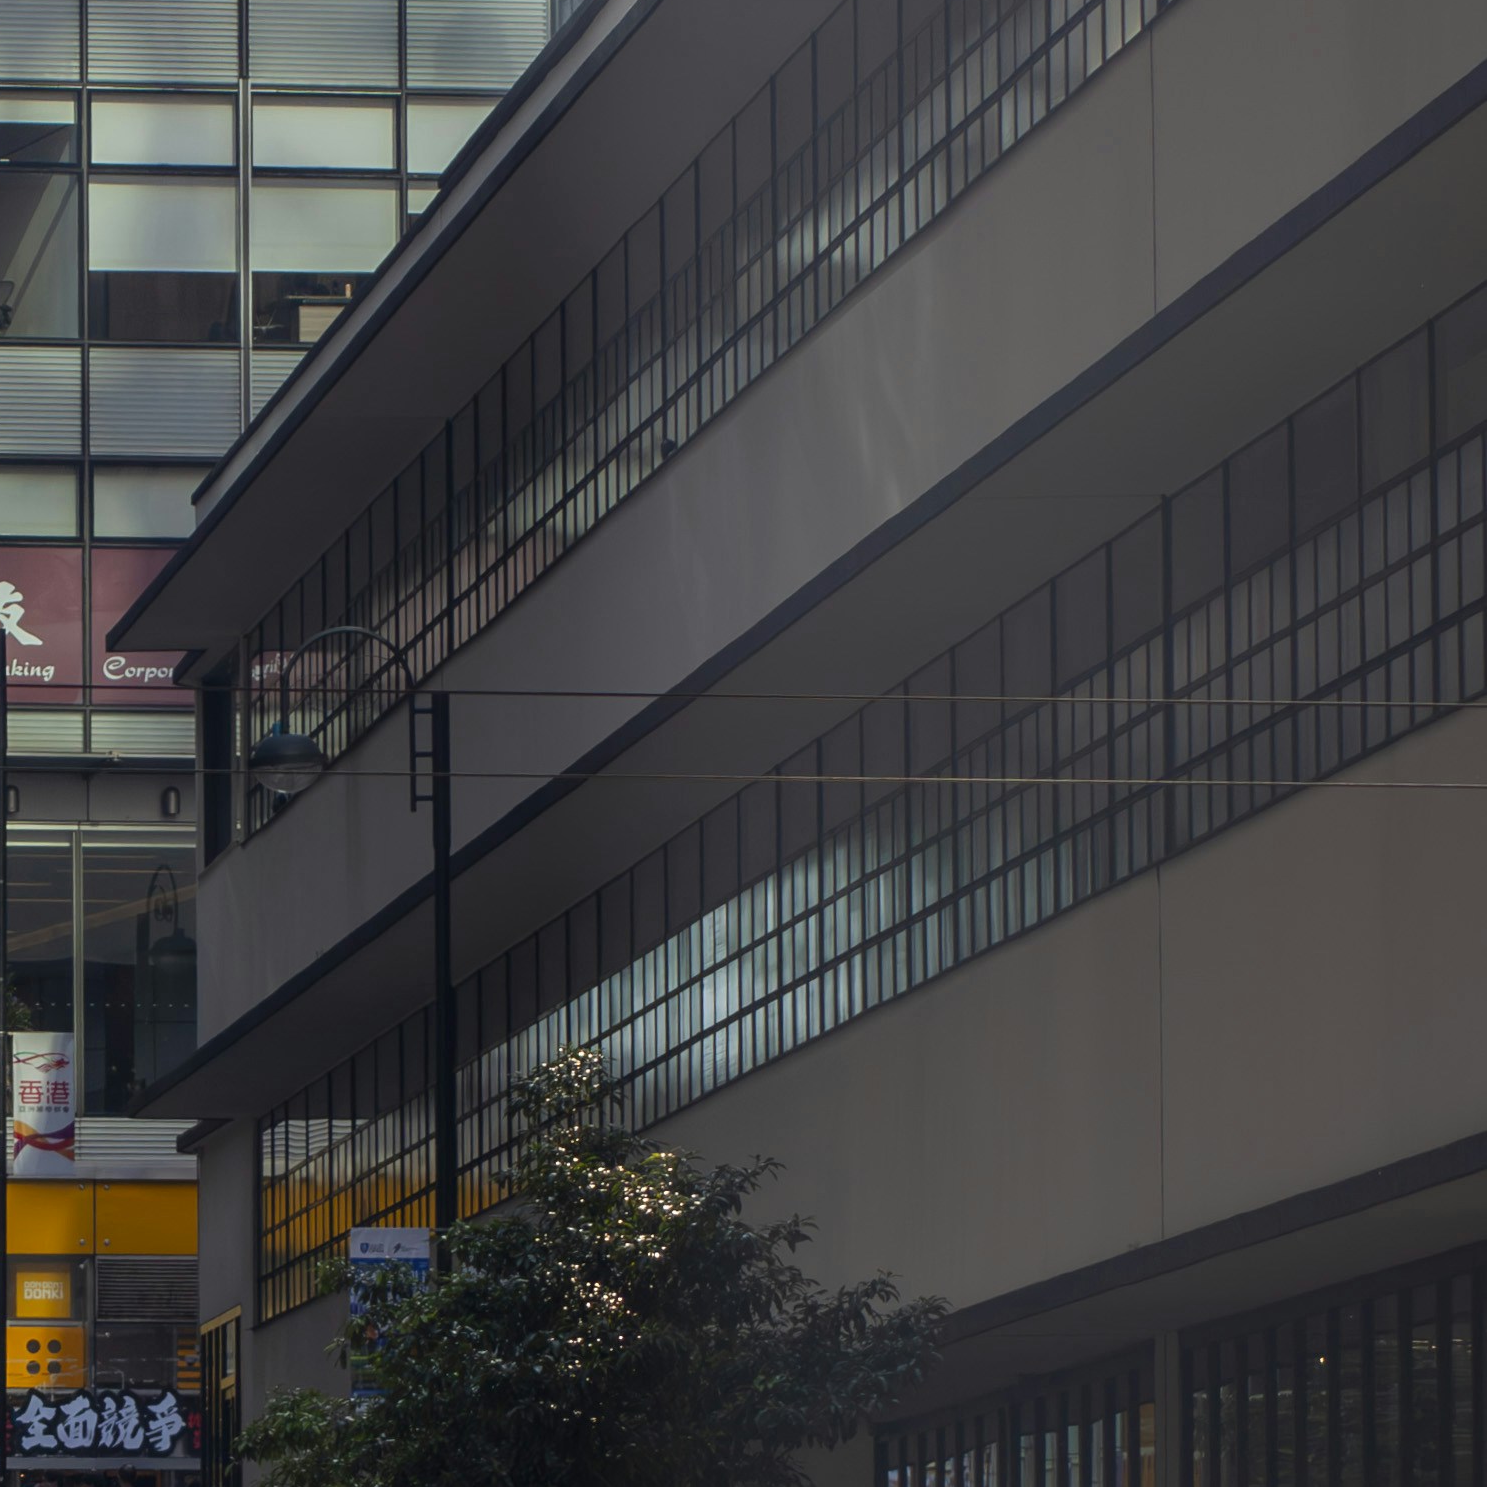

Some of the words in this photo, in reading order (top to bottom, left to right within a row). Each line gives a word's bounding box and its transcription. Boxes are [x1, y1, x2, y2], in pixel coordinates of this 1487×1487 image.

[19, 1080, 70, 1105] 香港
[16, 1392, 186, 1452] 全面競爭
